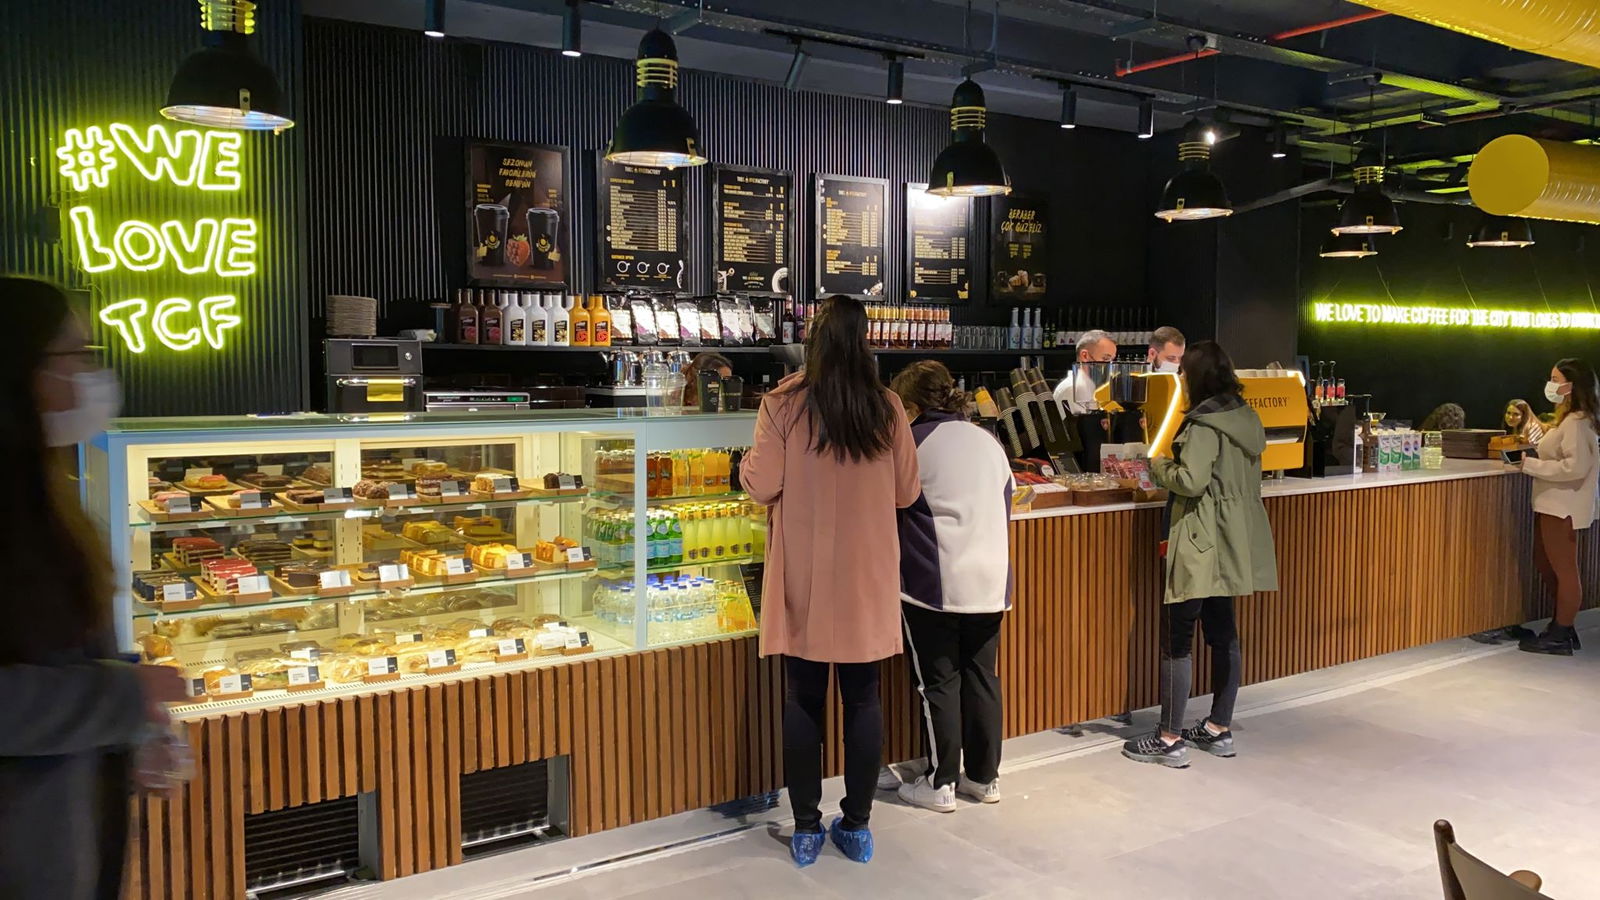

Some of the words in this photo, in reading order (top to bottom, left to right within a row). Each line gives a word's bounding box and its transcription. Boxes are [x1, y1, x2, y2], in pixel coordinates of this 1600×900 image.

[57, 123, 241, 191] #WE
[70, 206, 257, 277] LOVE
[100, 295, 241, 353] TCF
[1314, 302, 1334, 322] WE
[1335, 303, 1364, 323] LOVE
[1365, 304, 1381, 323] TO
[1381, 304, 1410, 324] MAKE
[1411, 305, 1450, 325] COFFEE
[1450, 308, 1470, 326] FOR
[1471, 309, 1490, 326] THE
[1490, 310, 1511, 328] CITY
